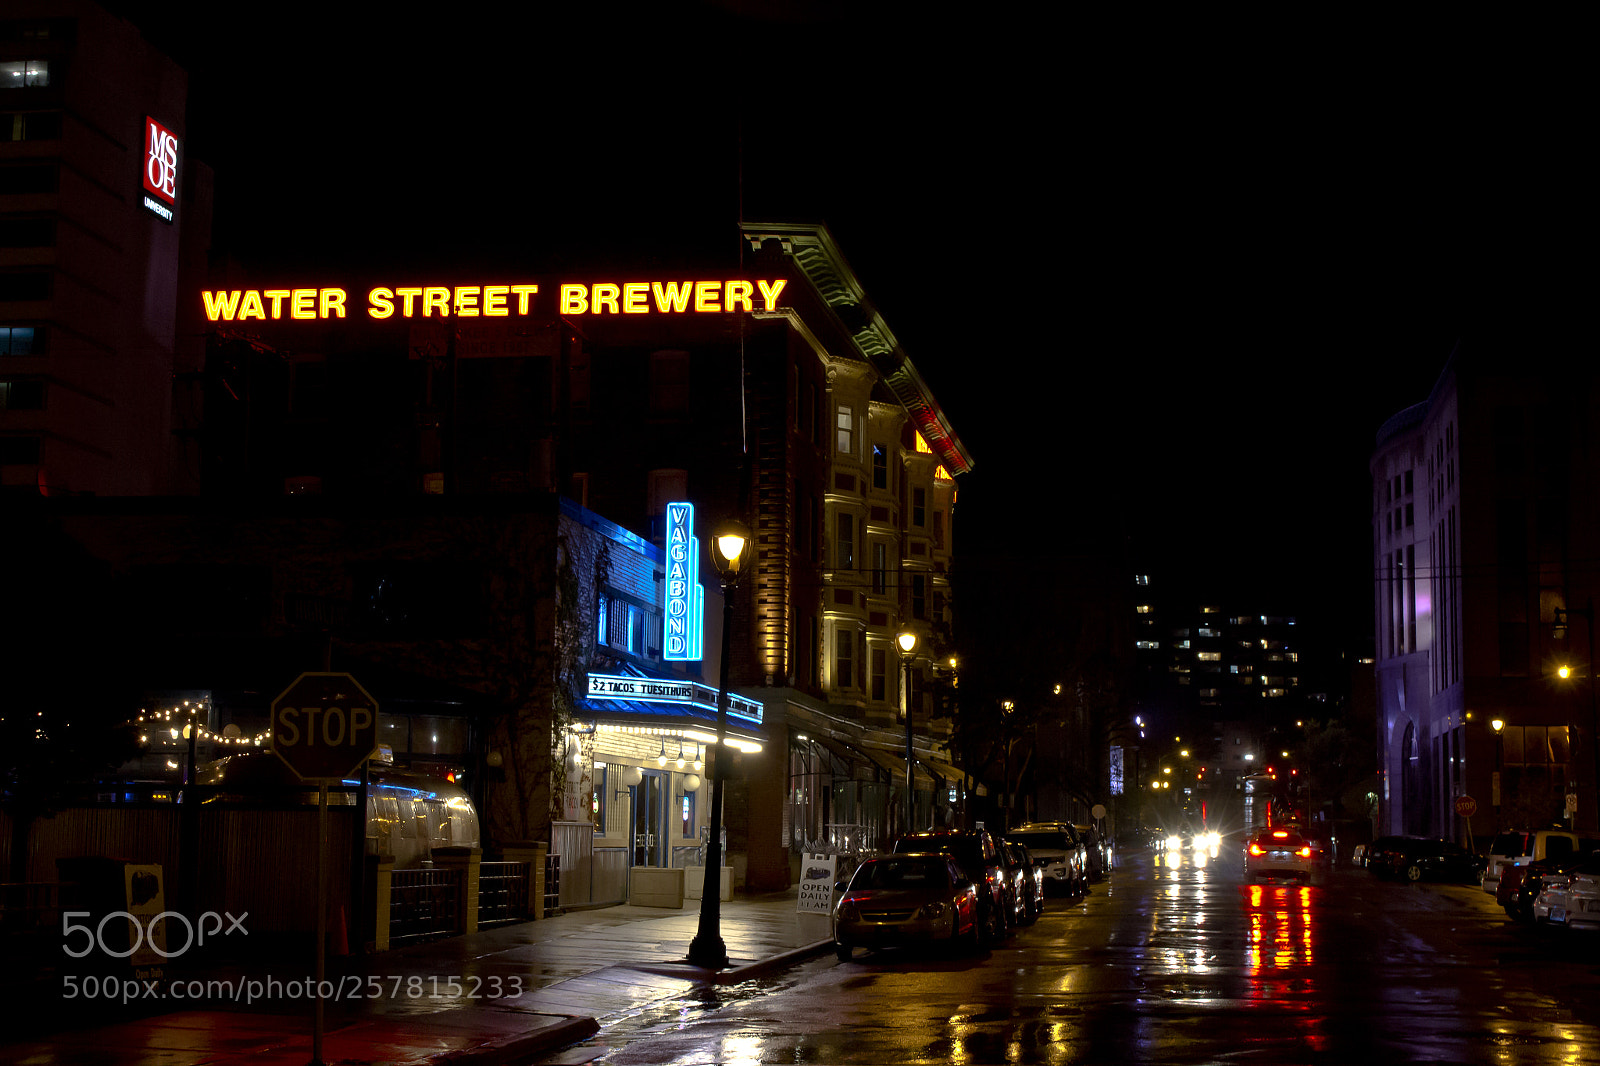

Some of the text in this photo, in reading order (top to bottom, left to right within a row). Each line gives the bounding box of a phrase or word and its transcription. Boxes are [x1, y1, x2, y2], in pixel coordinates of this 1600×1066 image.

[143, 195, 173, 222] UNIVERSITY
[201, 279, 788, 321] WATER STREET BREWERY
[668, 507, 688, 654] VAGABOND
[592, 677, 605, 691] $2
[608, 681, 635, 693] TACOS
[277, 706, 373, 747] STOP
[1456, 801, 1475, 812] STOP
[800, 891, 830, 901] DAILY
[802, 883, 830, 892] OPEN
